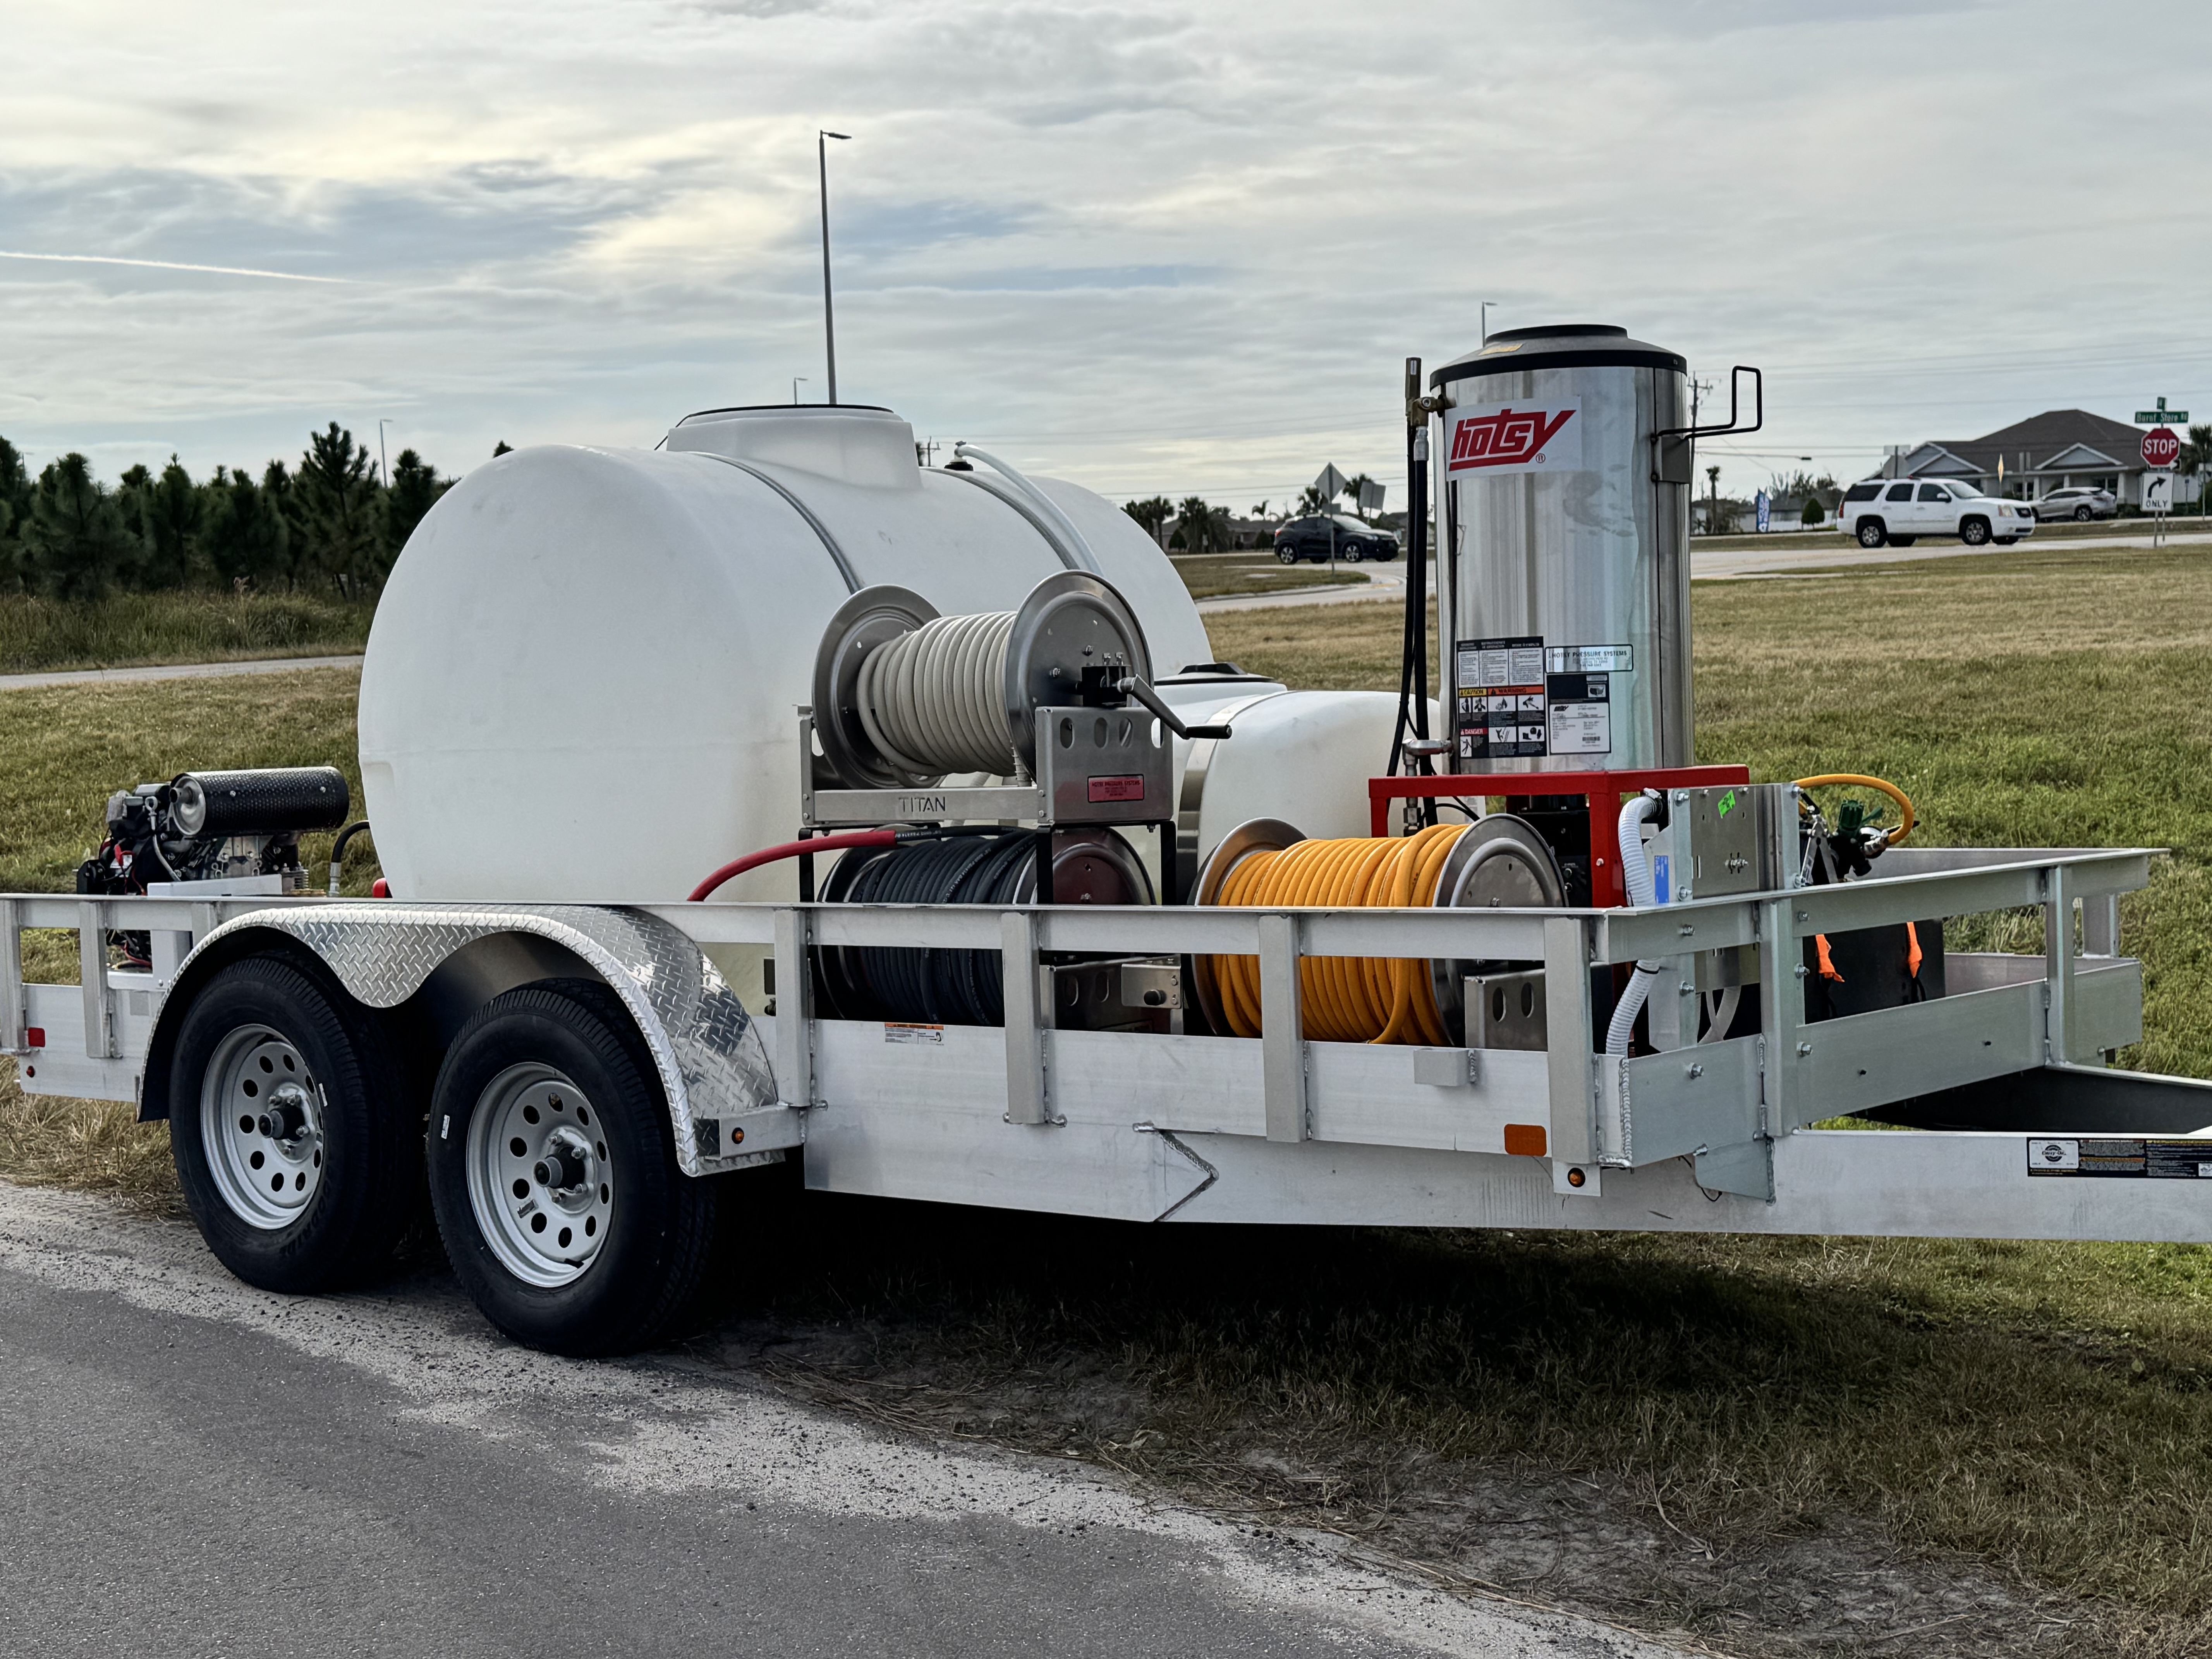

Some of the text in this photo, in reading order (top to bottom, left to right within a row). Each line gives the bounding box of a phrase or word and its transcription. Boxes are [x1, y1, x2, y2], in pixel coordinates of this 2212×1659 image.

[2137, 413, 2157, 422] Burnt
[2160, 412, 2178, 422] Store
[1449, 408, 1577, 471] hotsy
[2144, 439, 2178, 455] STOP
[2146, 499, 2168, 508] ONLY
[898, 796, 945, 812] TITAN
